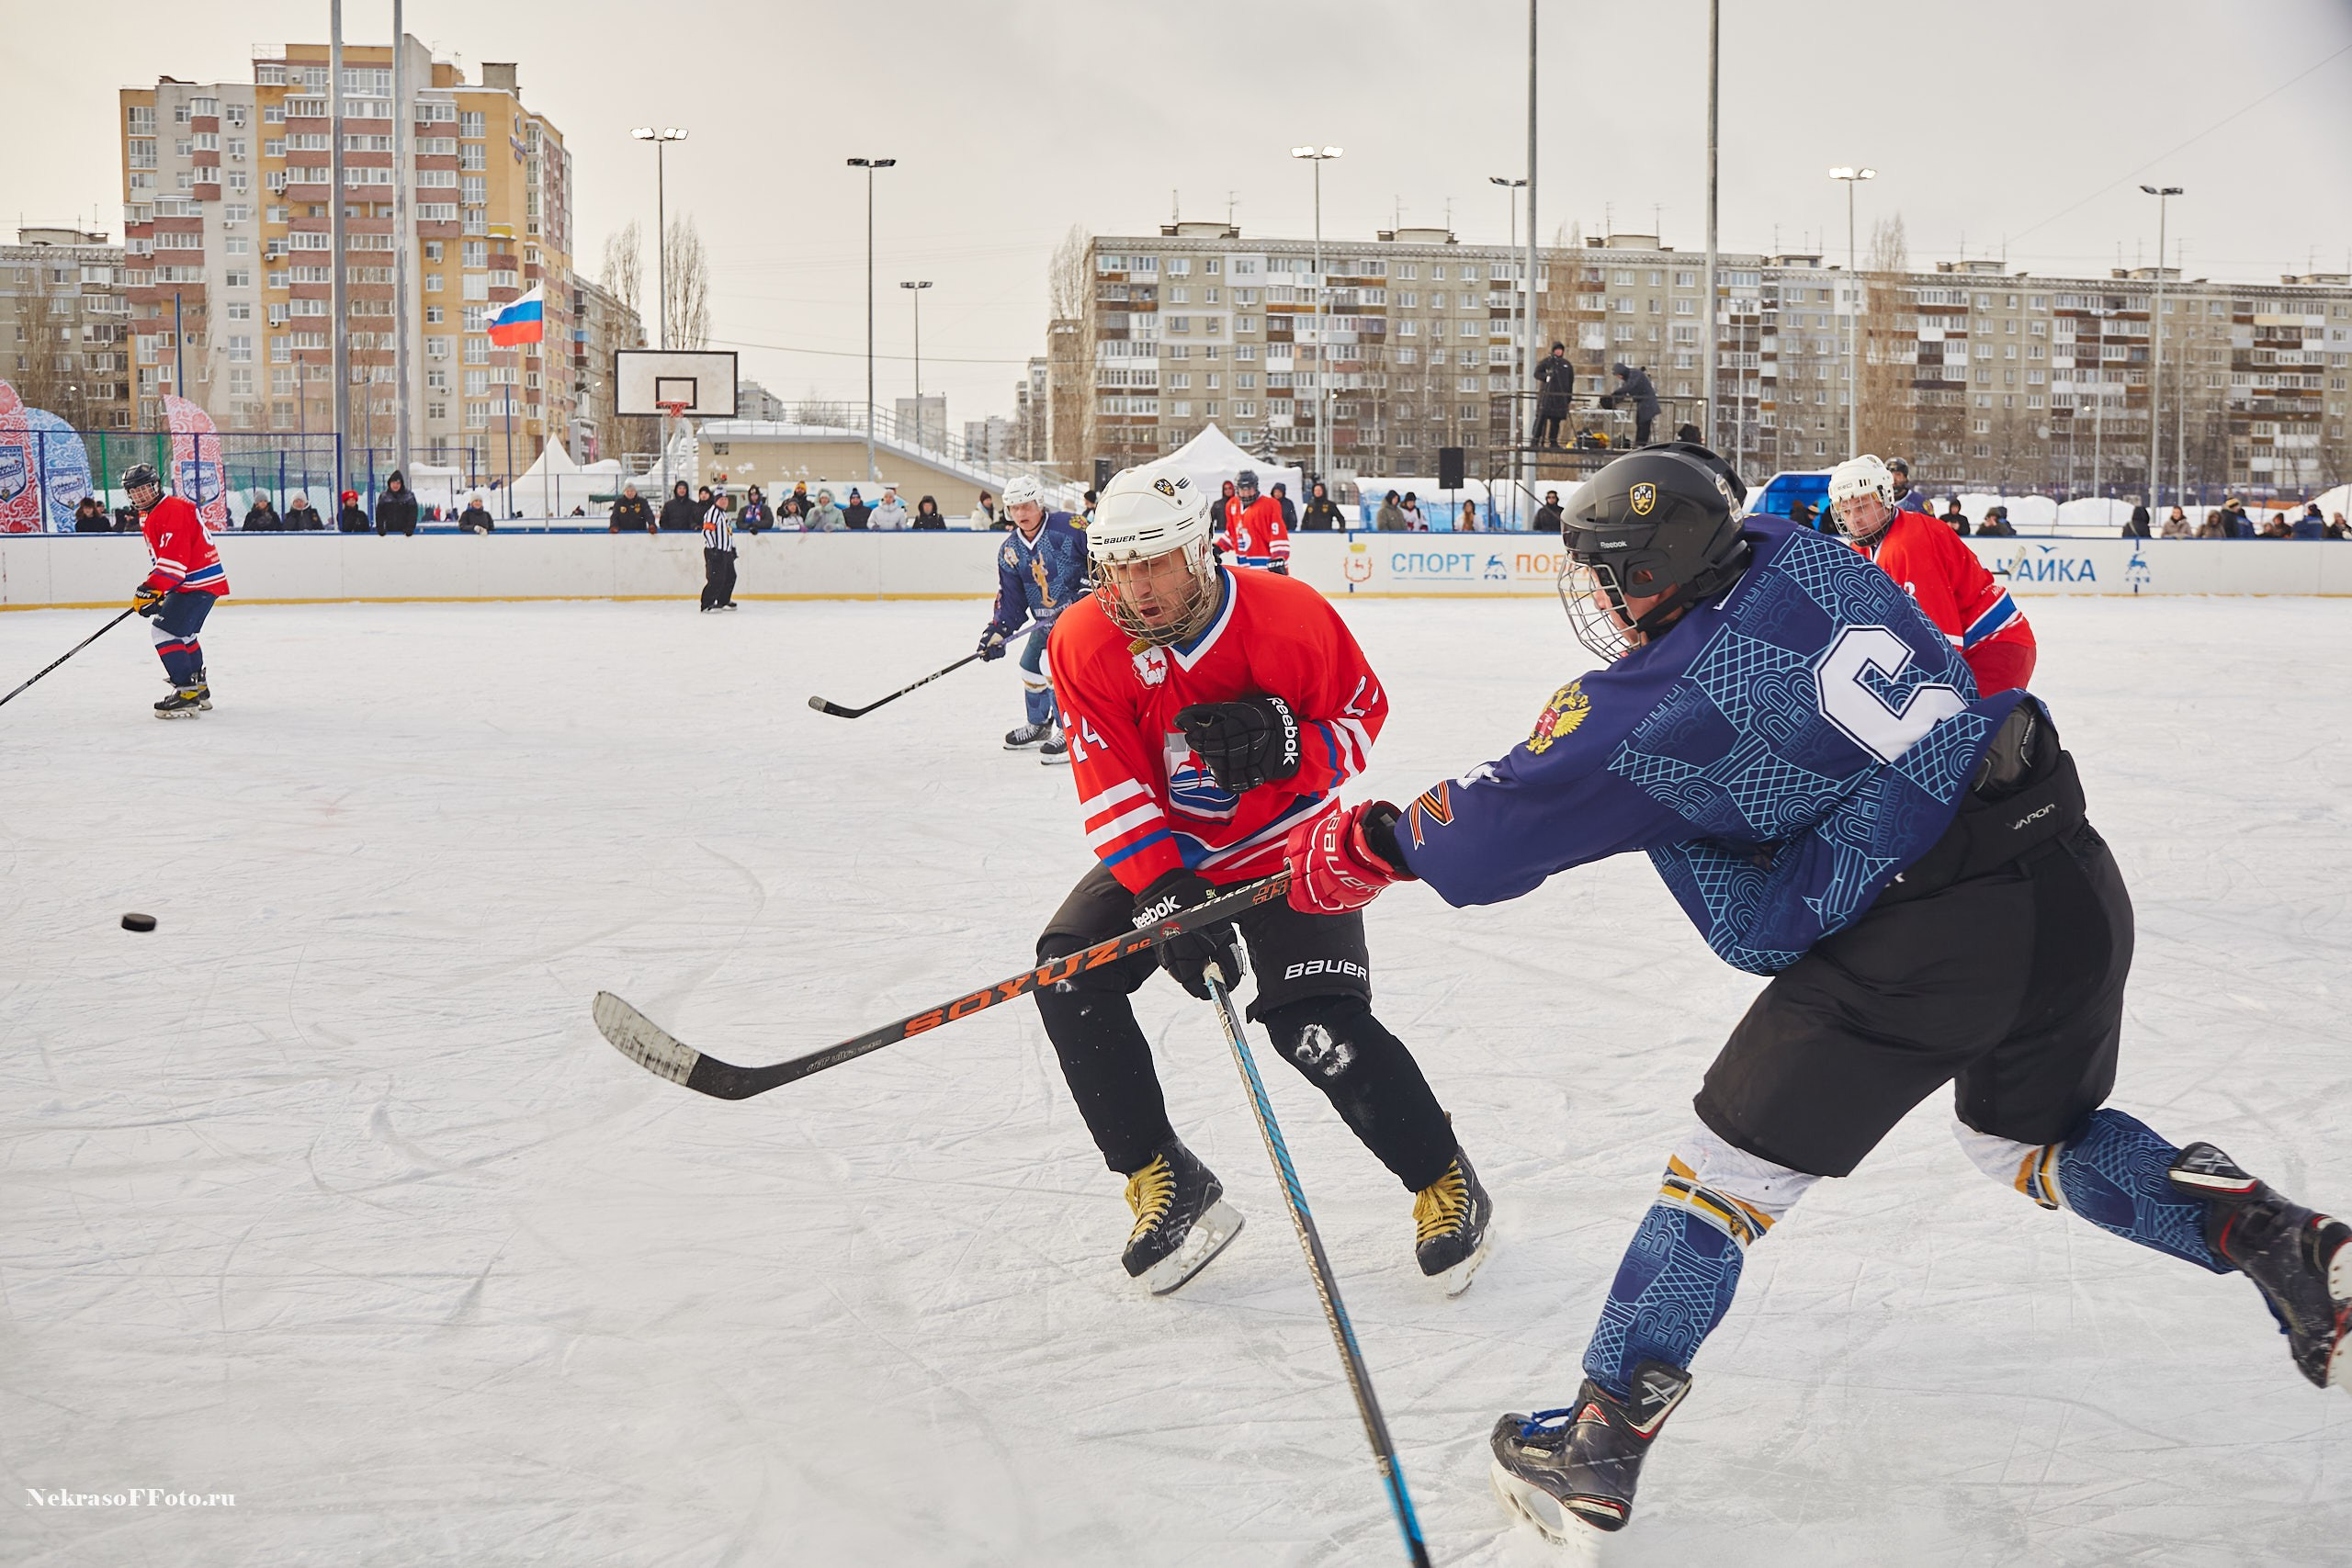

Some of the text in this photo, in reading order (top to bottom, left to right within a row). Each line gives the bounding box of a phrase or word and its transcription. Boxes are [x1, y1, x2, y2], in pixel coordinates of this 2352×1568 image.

[1272, 522, 1279, 535] 9
[1103, 535, 1136, 545] BAUER
[1600, 540, 1628, 548] Reebok
[1391, 552, 1476, 573] СПОРТ
[1266, 695, 1299, 766] Reebok
[1131, 894, 1182, 930] Reebok
[1283, 958, 1368, 982] BAUER
[904, 938, 1151, 1038] SOYUZ BC
